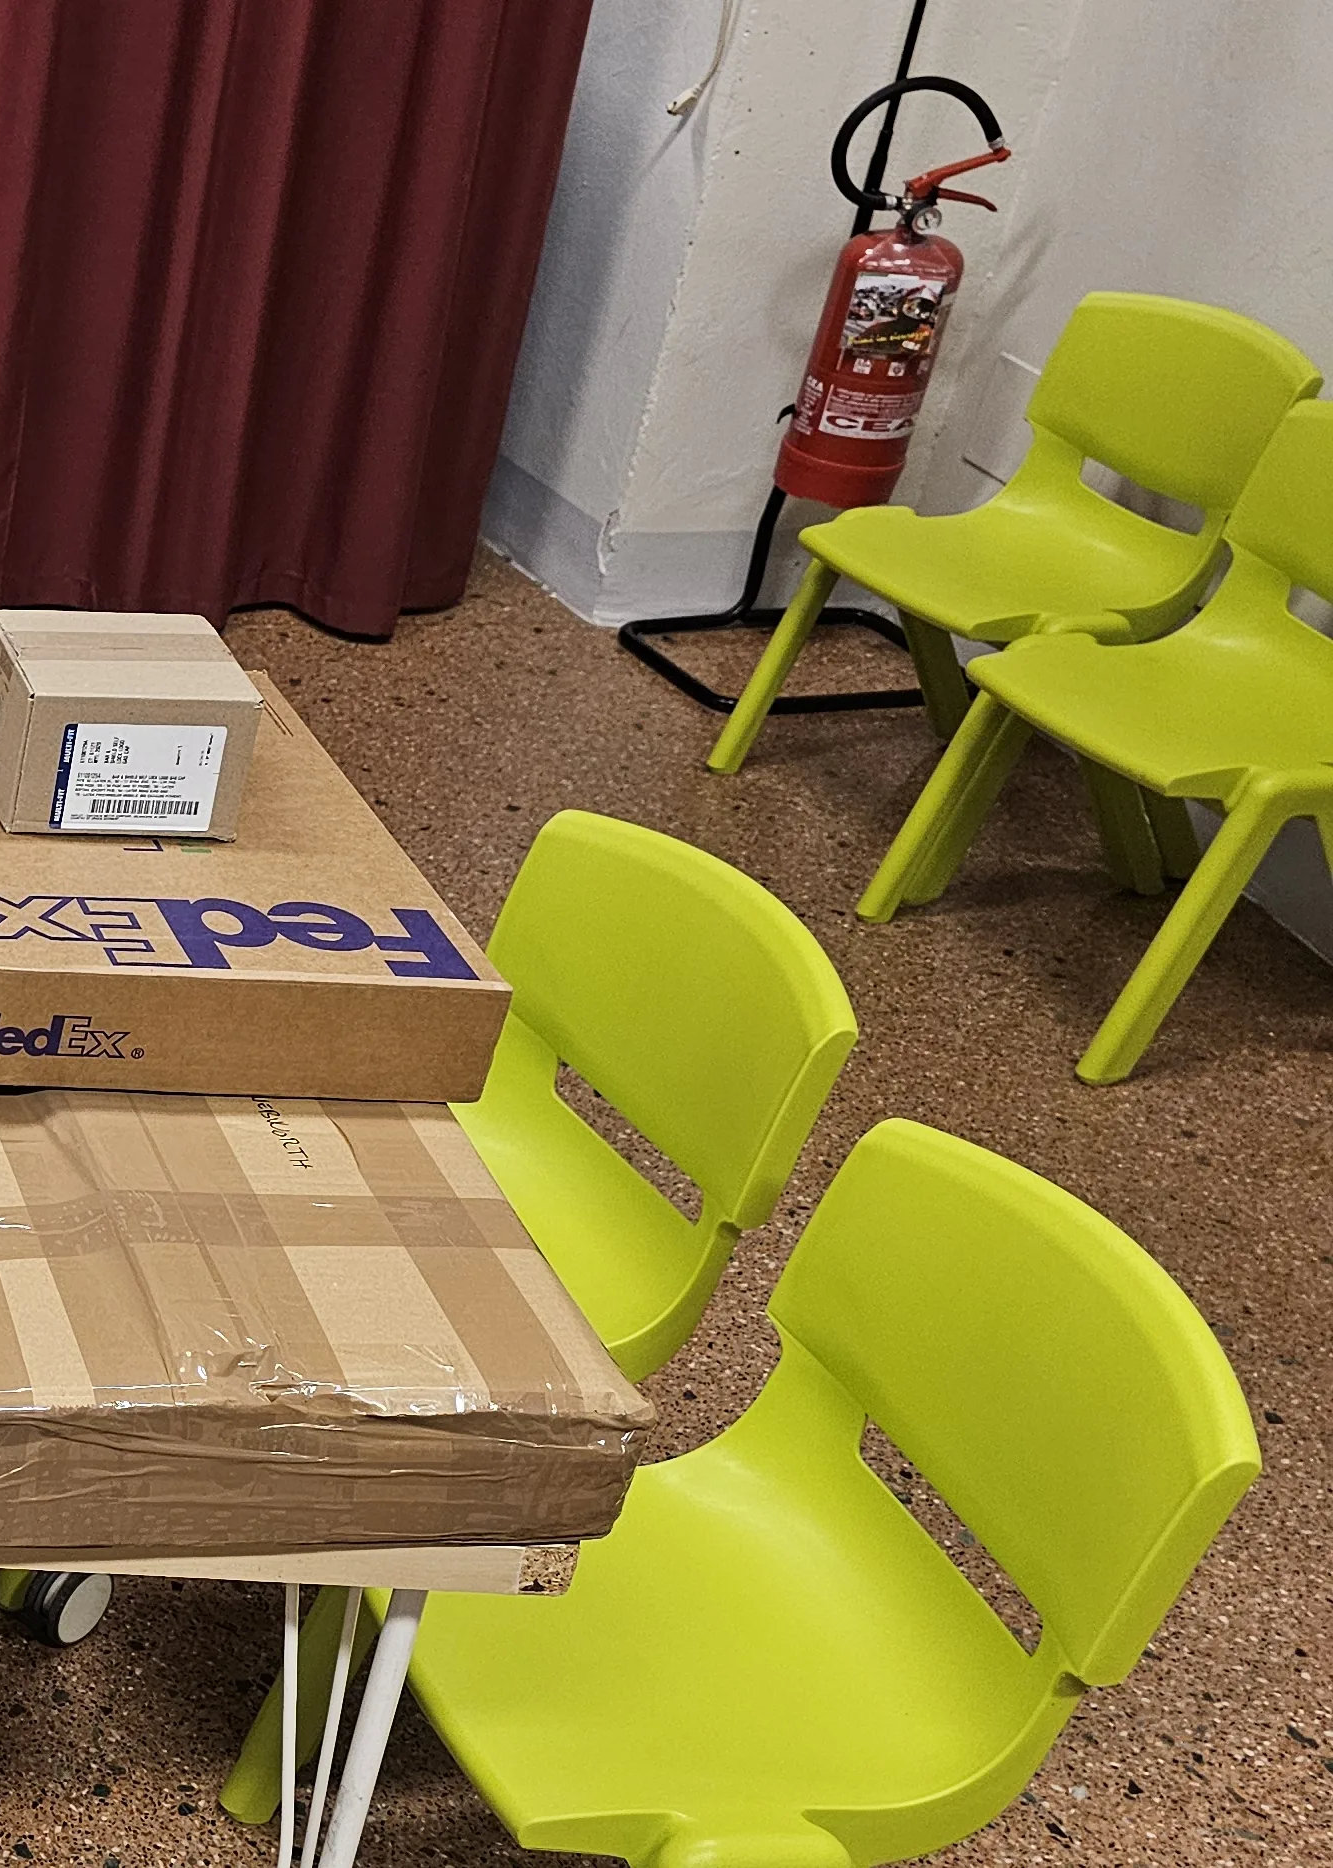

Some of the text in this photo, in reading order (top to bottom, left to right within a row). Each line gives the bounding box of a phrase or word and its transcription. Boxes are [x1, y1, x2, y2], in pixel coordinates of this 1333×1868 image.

[826, 415, 913, 433] CEA
[63, 728, 75, 763] MULTI-FIT
[54, 788, 65, 821] MULTI-FIT
